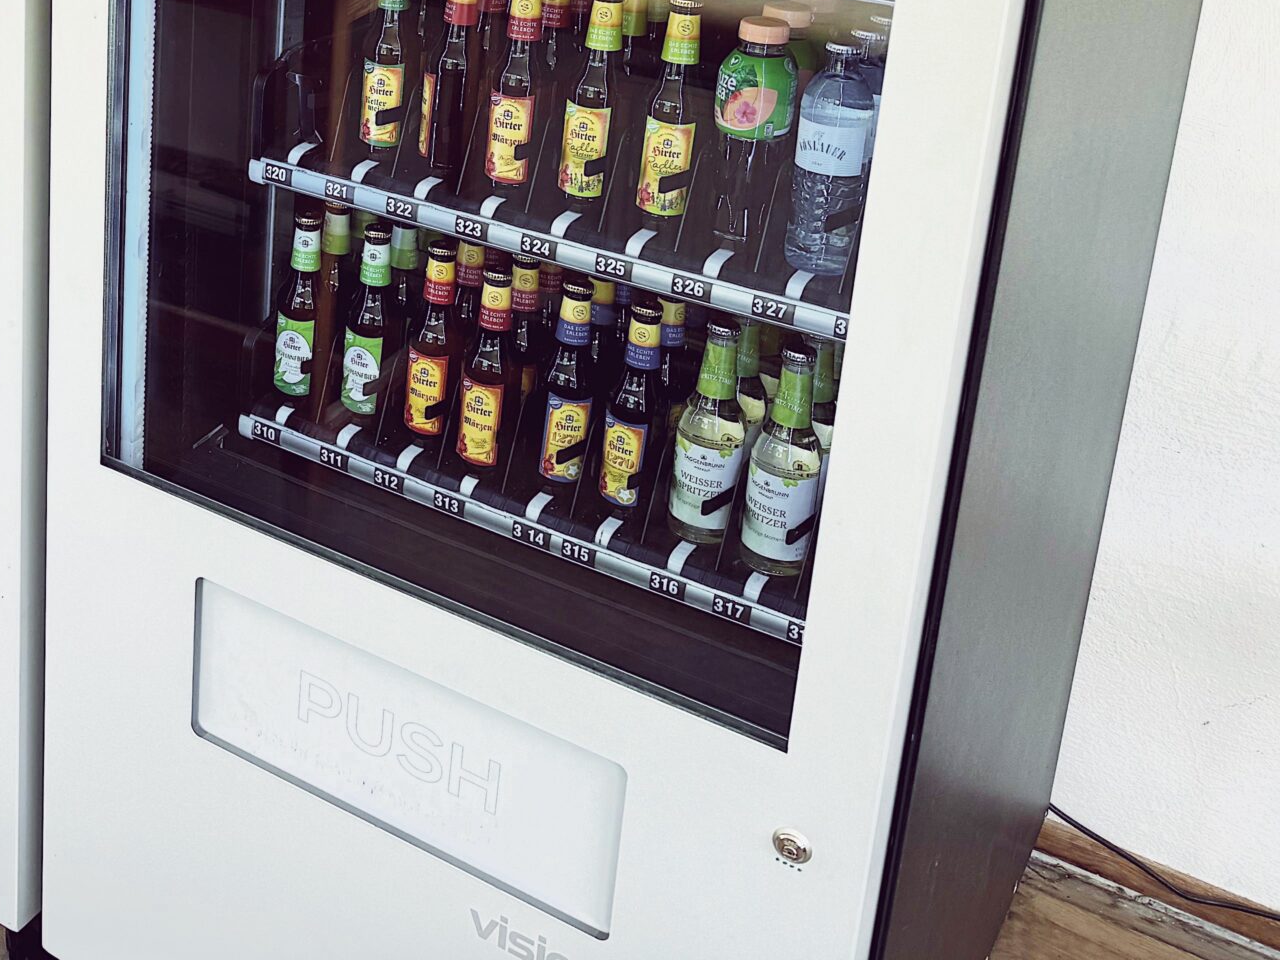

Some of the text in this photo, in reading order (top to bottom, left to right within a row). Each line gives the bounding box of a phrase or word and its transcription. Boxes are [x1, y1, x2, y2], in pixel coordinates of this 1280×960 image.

[369, 85, 393, 96] Hirter
[494, 117, 523, 131] Hirter
[570, 128, 596, 142] Hirter
[564, 138, 598, 154] Radler
[652, 146, 682, 159] Hirter
[648, 155, 682, 171] Radler
[266, 165, 286, 182] 320
[326, 181, 347, 199] 321
[387, 199, 412, 218] 322
[456, 218, 482, 237] 323
[522, 237, 550, 256] 324
[596, 257, 626, 276] 325
[673, 278, 704, 297] 326
[753, 298, 787, 319] 327
[628, 351, 651, 361] ERLEBEN
[412, 373, 438, 388] Hirter
[410, 386, 438, 402] Märzen
[465, 401, 493, 417] Hirter
[255, 423, 275, 441] 310
[464, 415, 493, 431] Märzen
[554, 420, 581, 432] Hirter
[608, 440, 633, 456] Hirter
[321, 450, 342, 468] 311
[606, 450, 635, 470] 1270
[684, 453, 725, 469] TAGGENBRUNN
[374, 470, 398, 489] 312
[681, 470, 723, 489] WEISSER
[751, 477, 789, 499] TAGGENBRUNN
[434, 494, 459, 513] 313
[748, 495, 787, 519] WEISSER
[513, 524, 544, 546] 314
[563, 541, 589, 562] 315
[651, 574, 678, 595] 316
[714, 598, 743, 618] 317
[297, 670, 502, 816] PUSH
[470, 908, 569, 960] visi
